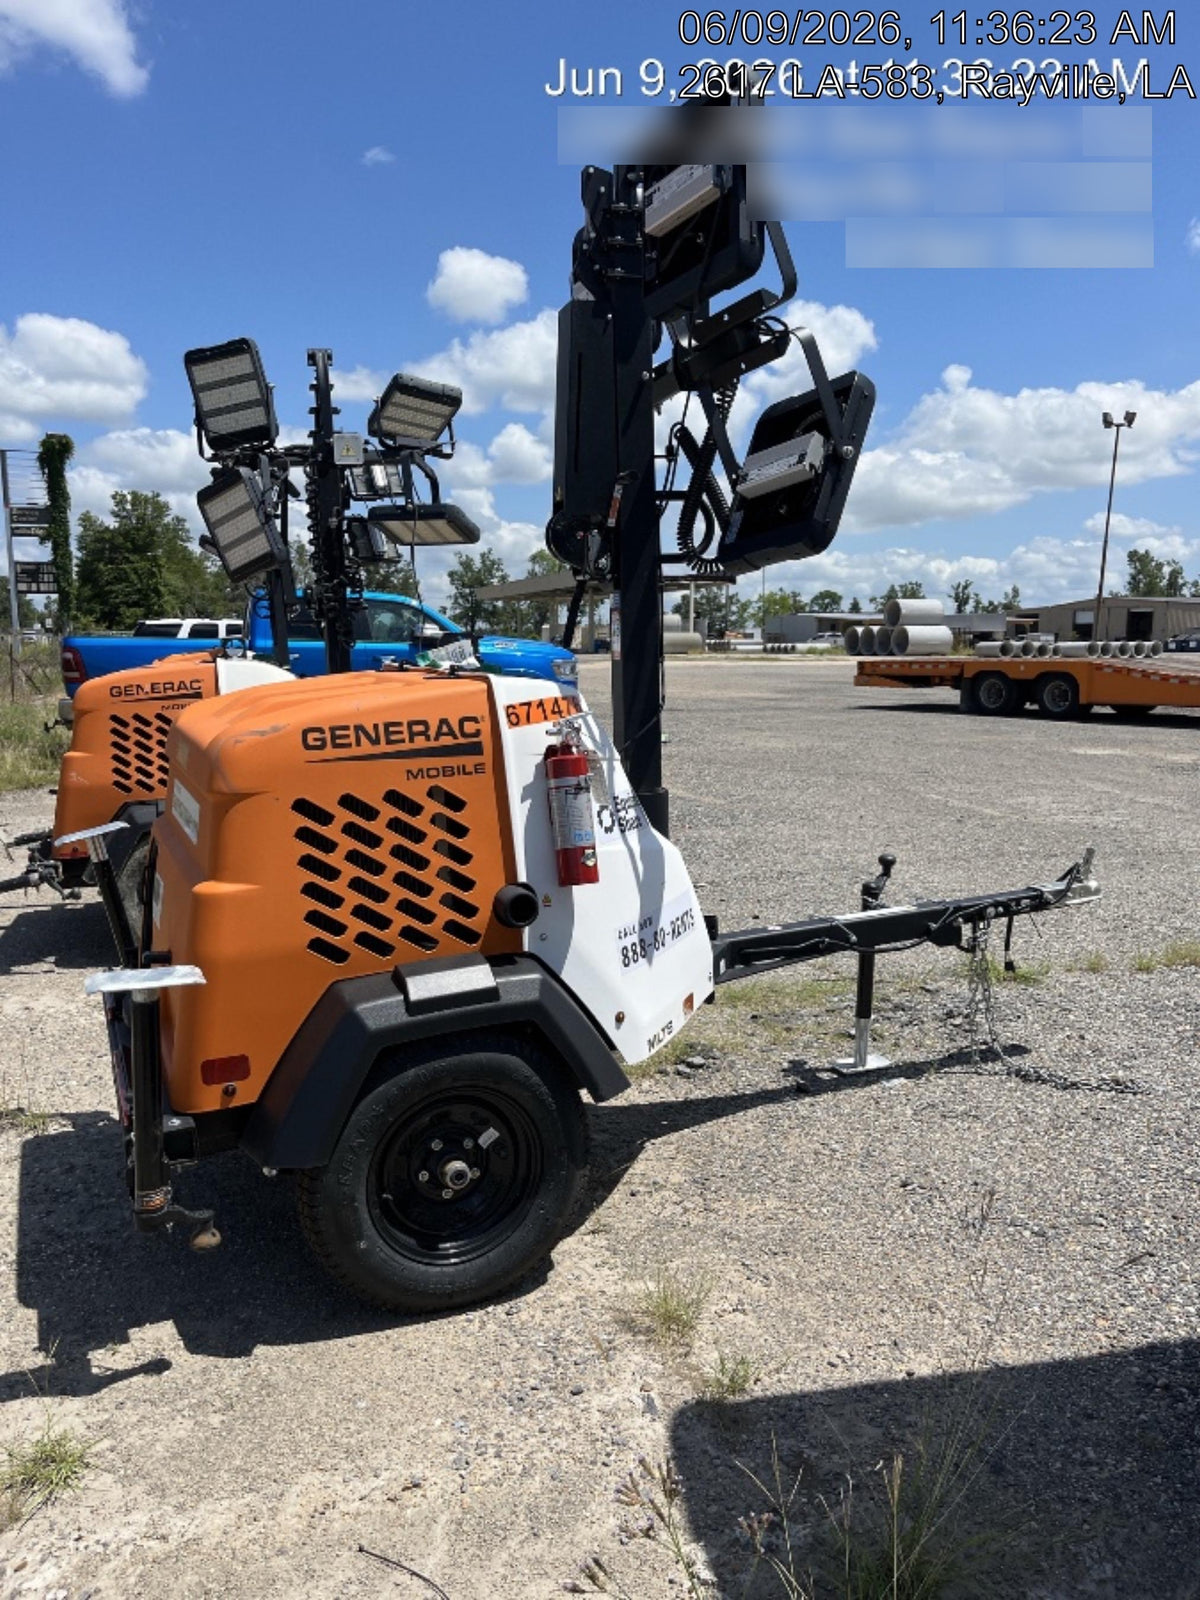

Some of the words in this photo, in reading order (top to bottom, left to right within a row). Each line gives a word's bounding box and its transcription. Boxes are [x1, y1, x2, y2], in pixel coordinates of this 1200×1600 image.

[109, 679, 203, 698] GENERAC
[301, 715, 482, 751] GENERAC
[405, 762, 487, 781] MOBILE
